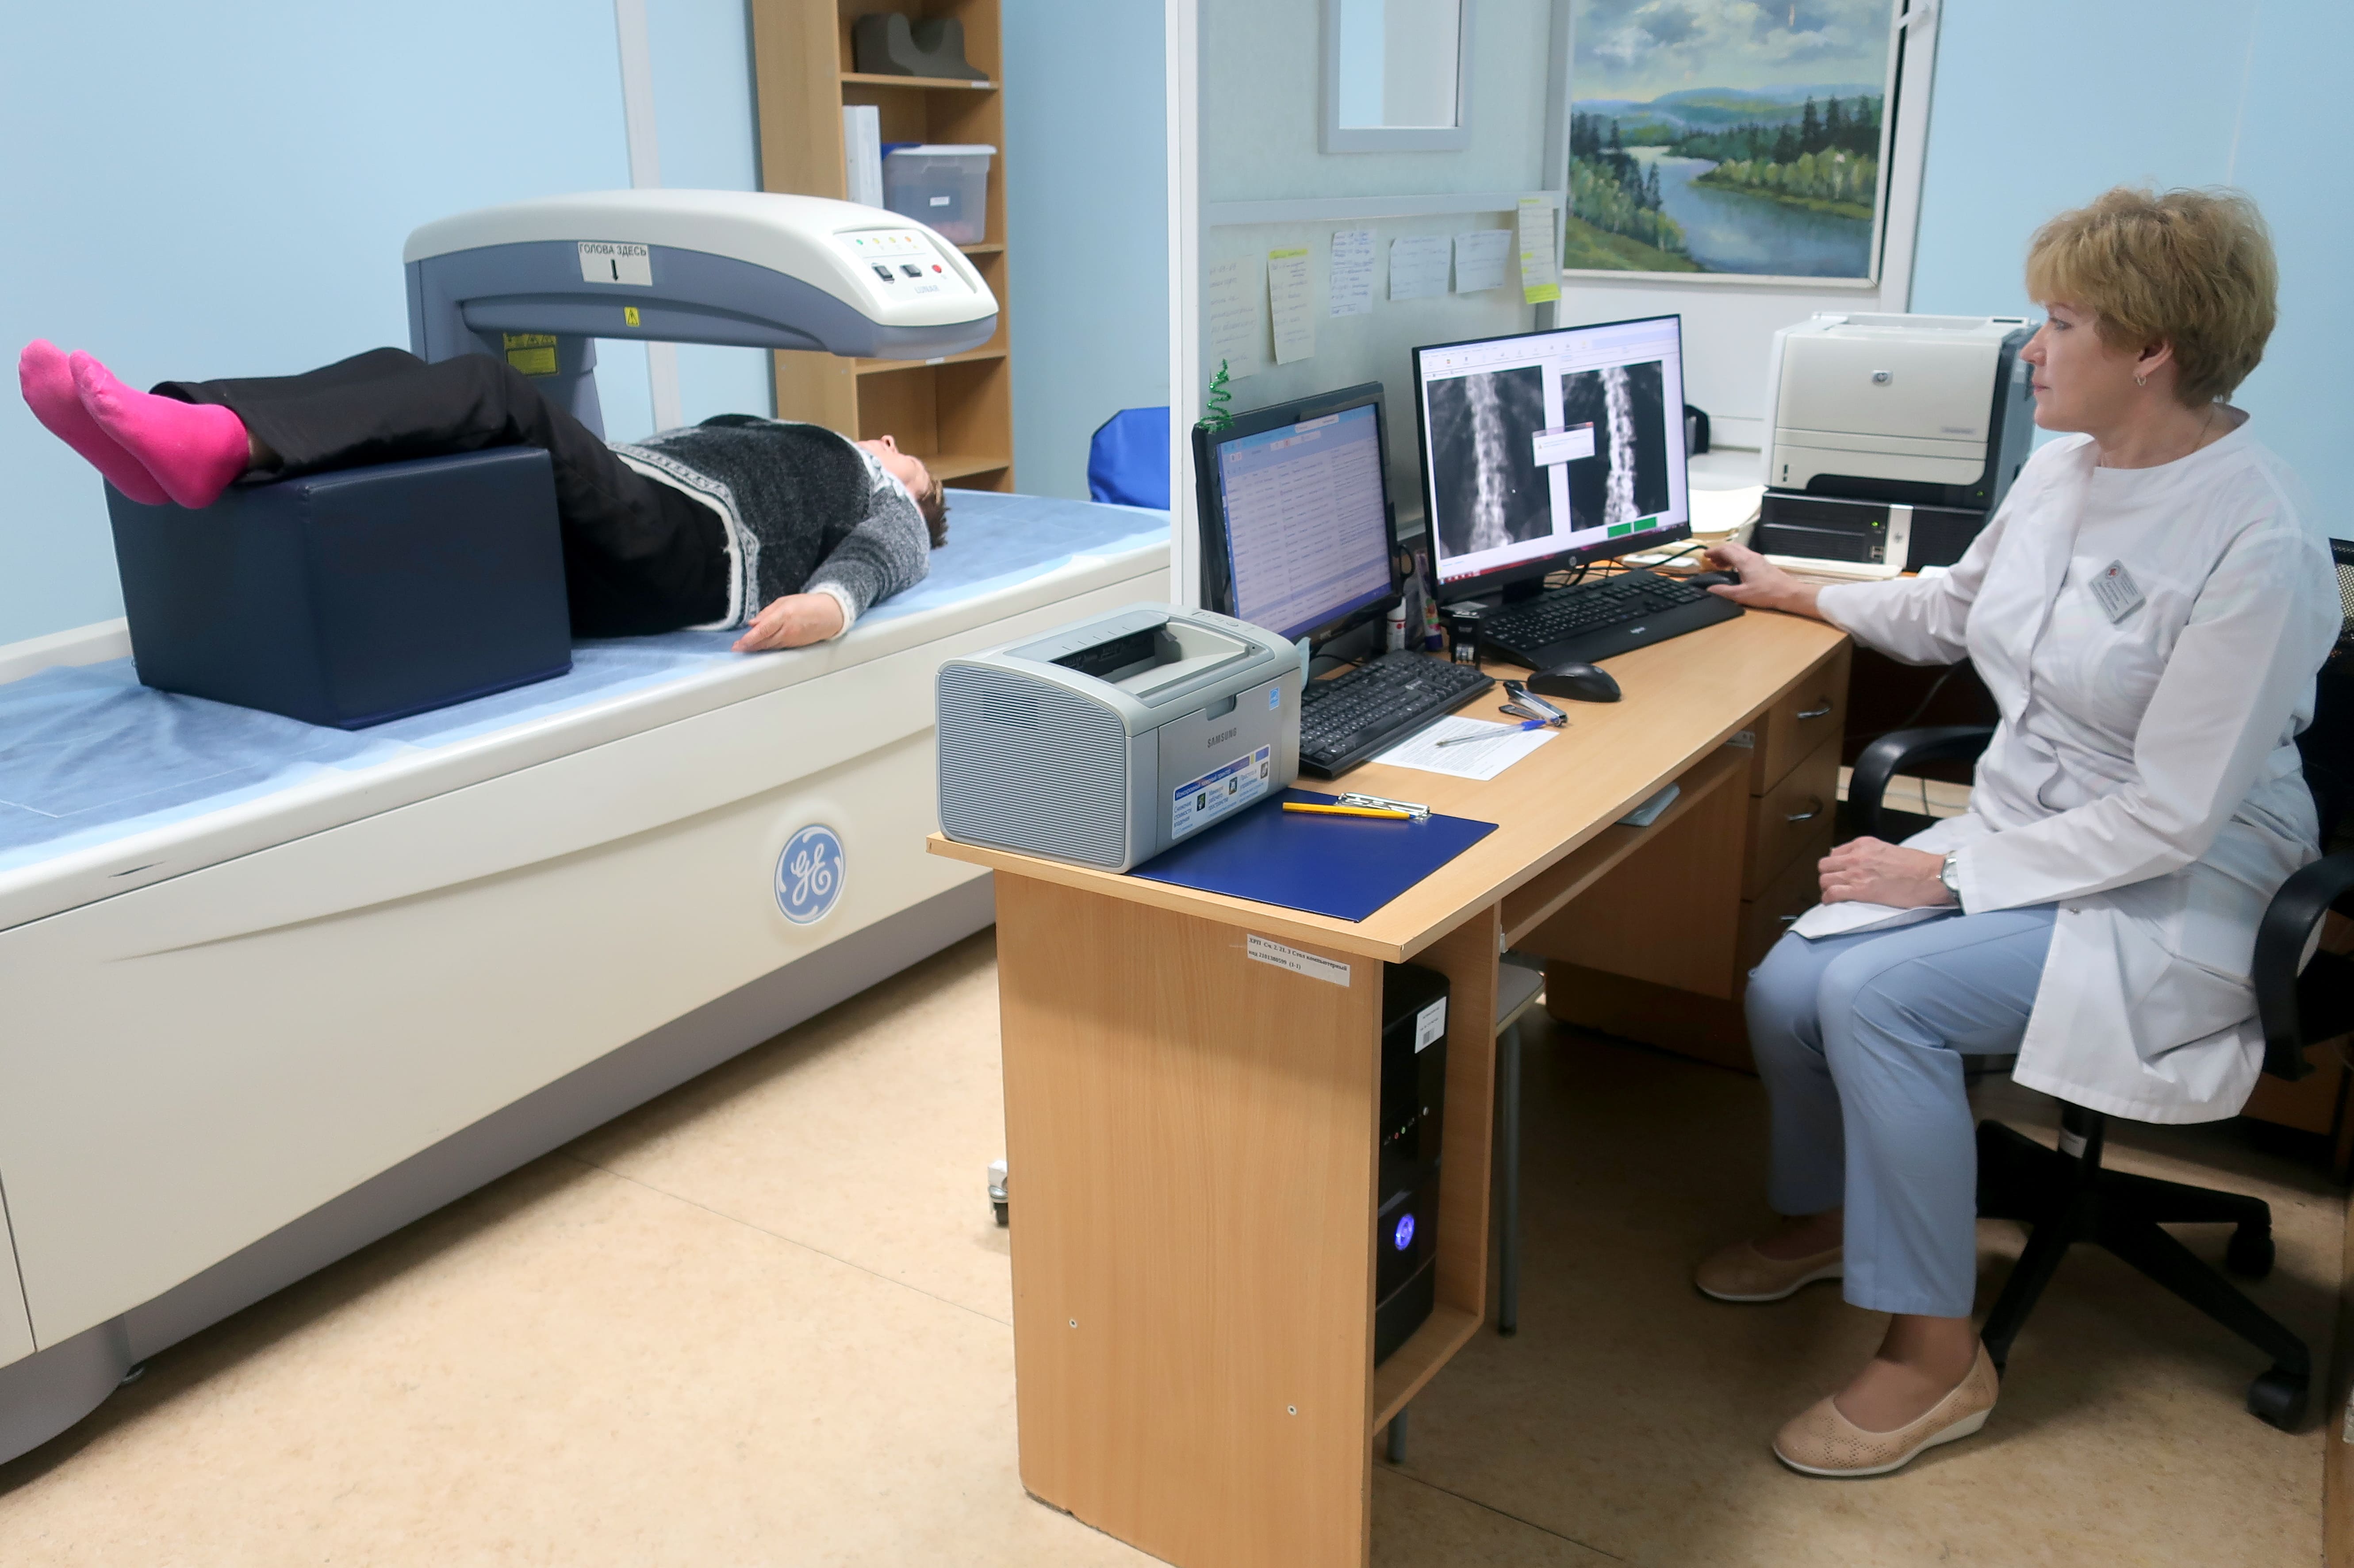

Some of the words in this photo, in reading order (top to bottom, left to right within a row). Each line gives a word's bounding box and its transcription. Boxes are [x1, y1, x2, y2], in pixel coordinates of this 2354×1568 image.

[579, 244, 614, 254] ГОЛОВА
[617, 245, 646, 257] ЗДЕСЬ
[1207, 728, 1237, 748] SAMSUNG
[1289, 961, 1301, 970] (1-1)
[1306, 956, 1347, 971] компьютерный
